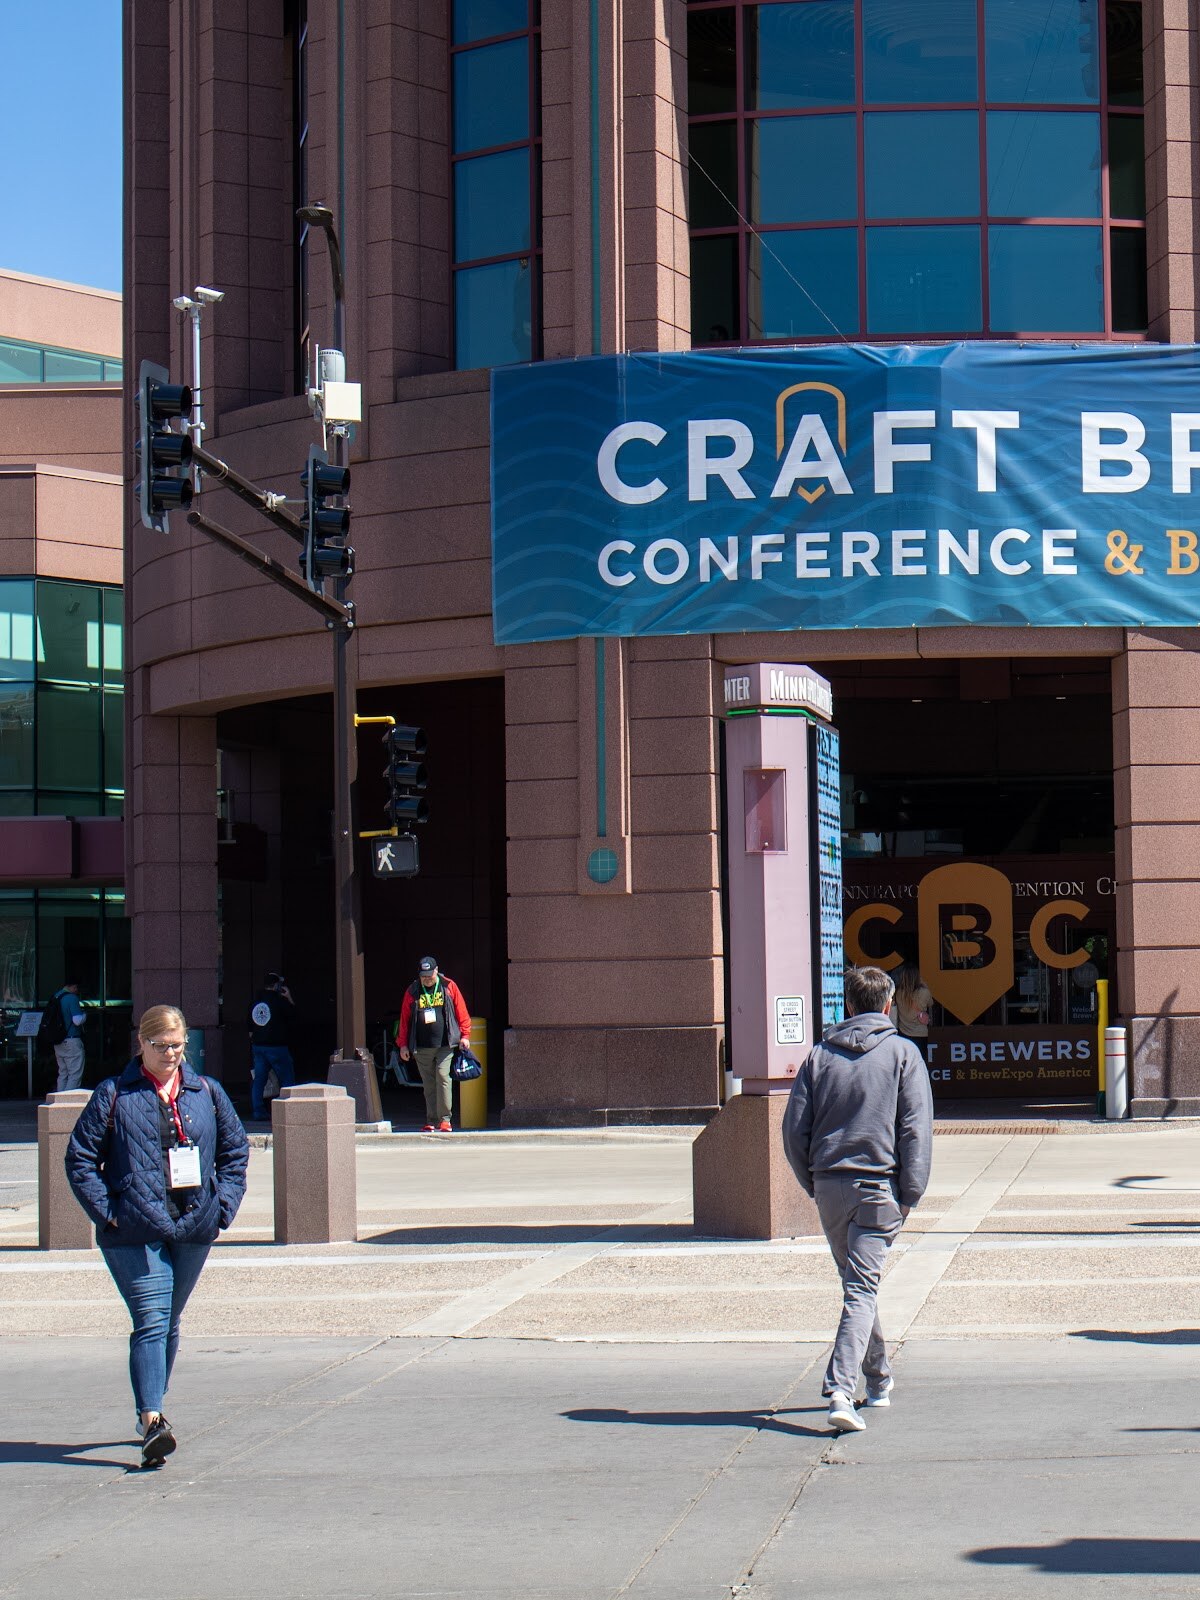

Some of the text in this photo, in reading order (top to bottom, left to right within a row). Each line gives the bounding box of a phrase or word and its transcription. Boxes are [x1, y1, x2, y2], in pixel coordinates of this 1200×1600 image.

[597, 409, 1020, 505] CRAFT
[598, 528, 1078, 587] CONFERENCE
[1104, 529, 1144, 575] &
[950, 1039, 1091, 1063] BREWERS
[955, 1069, 966, 1080] &
[970, 1067, 1034, 1082] BrewExpo
